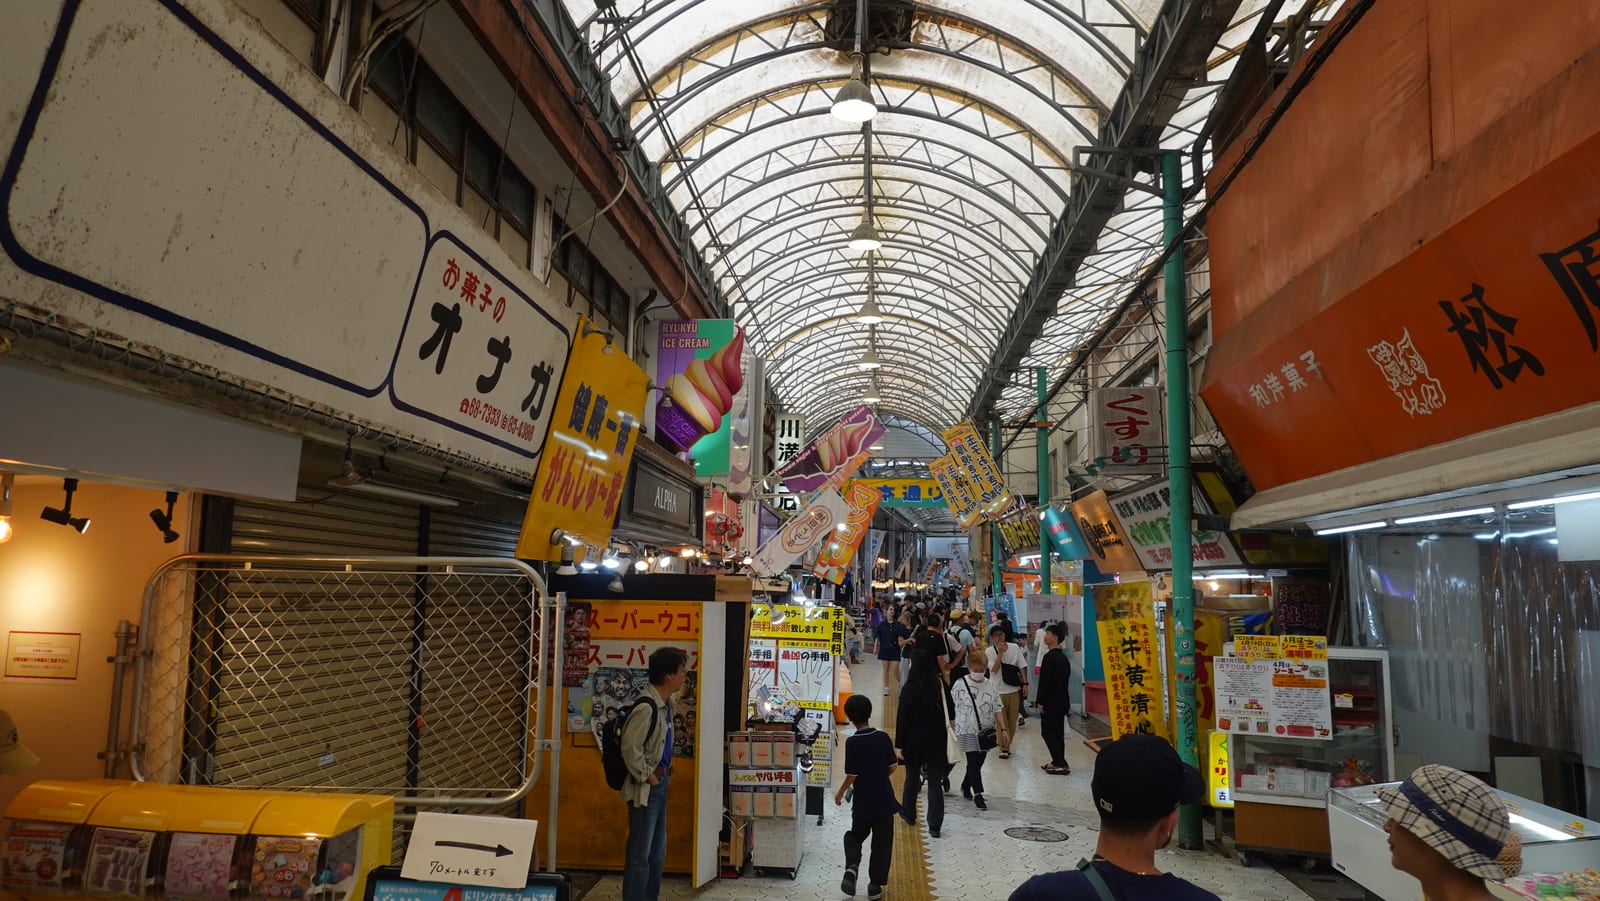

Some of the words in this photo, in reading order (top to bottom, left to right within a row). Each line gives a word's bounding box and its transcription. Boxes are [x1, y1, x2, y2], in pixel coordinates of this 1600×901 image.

[442, 258, 506, 323] お菓子の
[662, 322, 698, 333] RYUKYU
[662, 338, 676, 348] ICE
[678, 338, 710, 348] CREAM
[419, 302, 554, 421] オナガ
[1250, 350, 1325, 409] 和洋菓子
[568, 380, 634, 457] 健康一番
[1105, 393, 1149, 464] くすり
[654, 486, 677, 512] ALPHA
[831, 608, 844, 655] 手相無料
